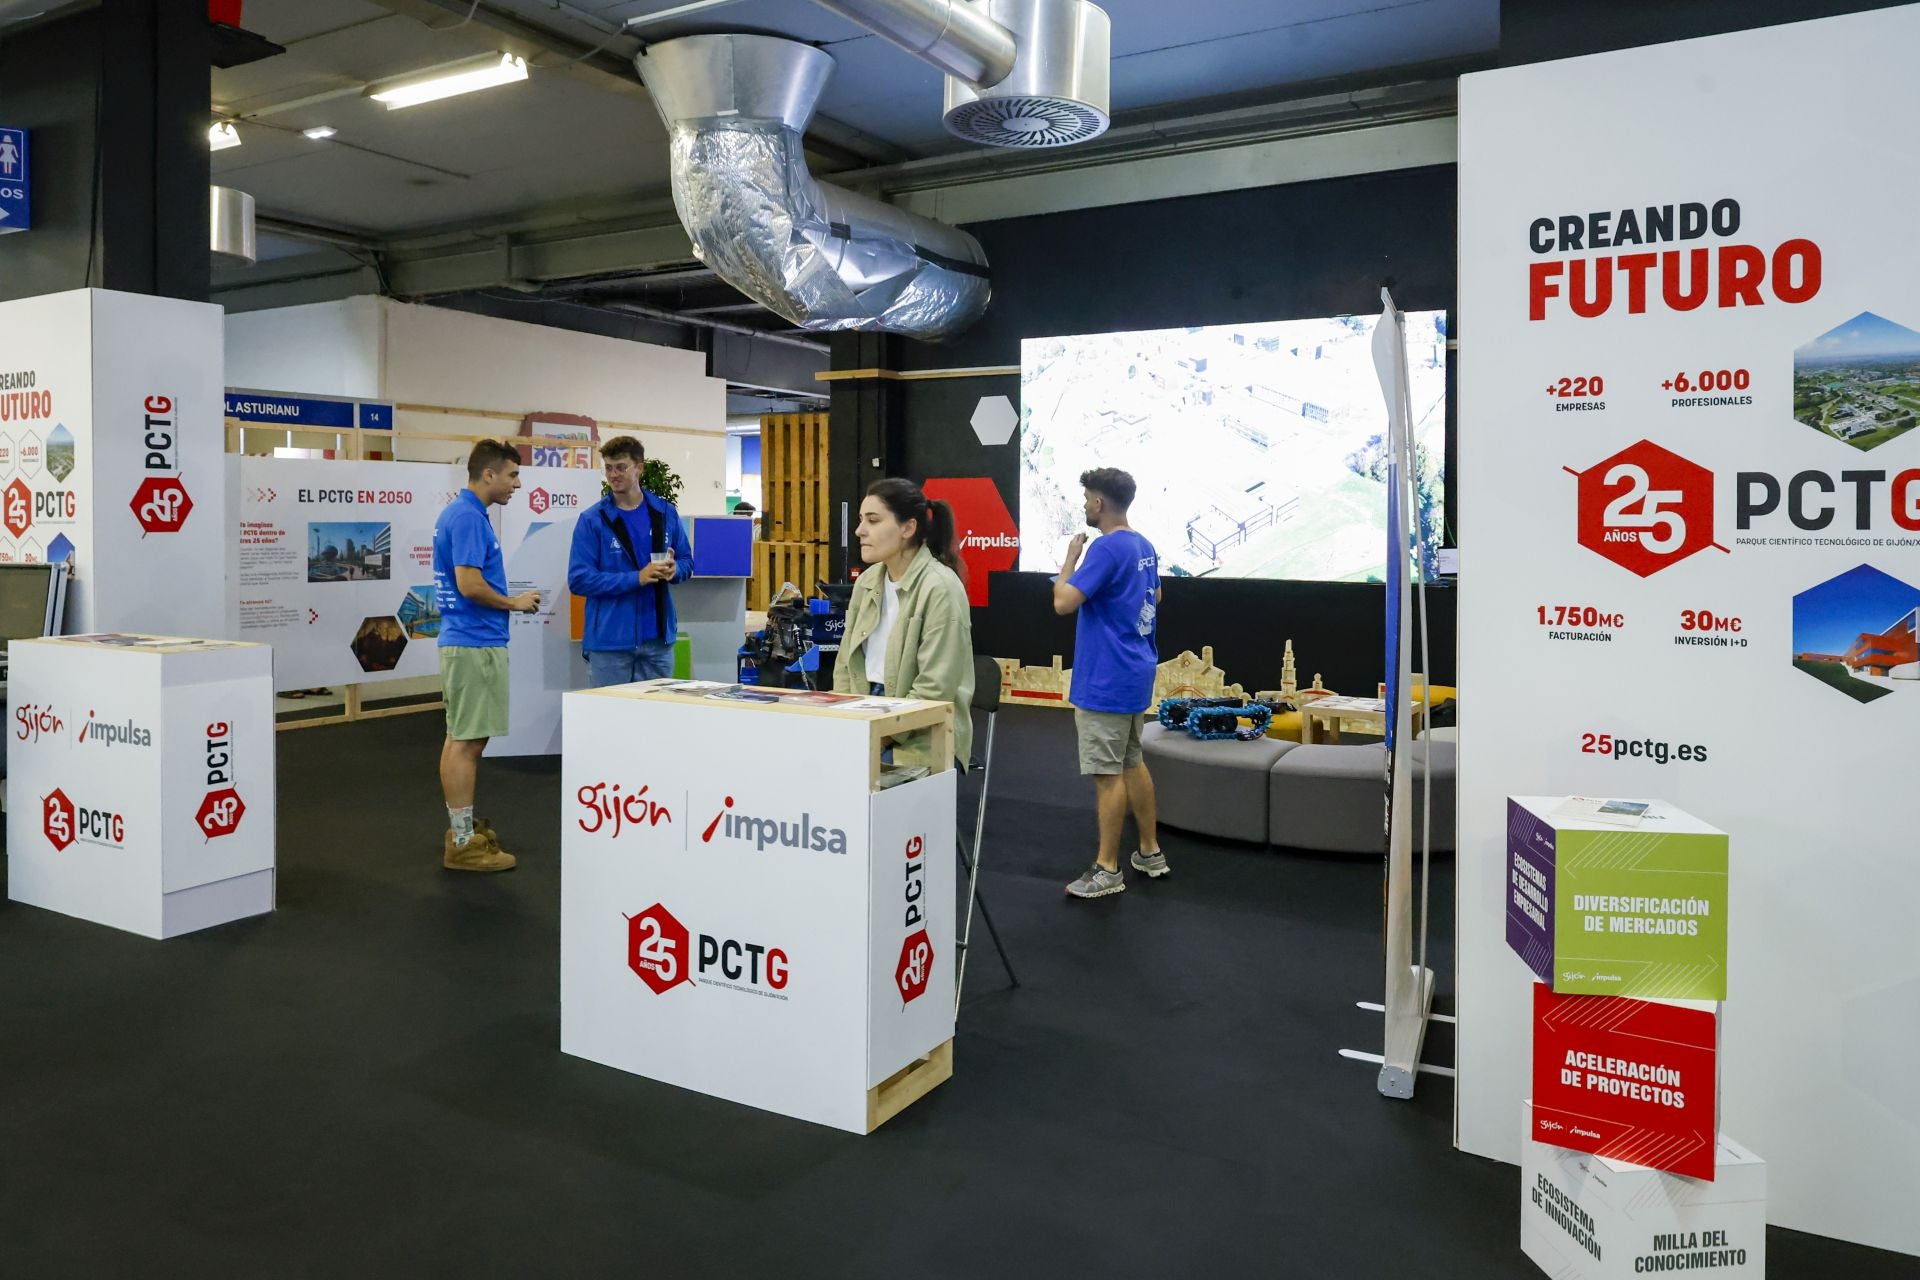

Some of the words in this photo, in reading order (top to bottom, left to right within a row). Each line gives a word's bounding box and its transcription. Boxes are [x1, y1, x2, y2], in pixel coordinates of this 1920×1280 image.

[1, 187, 24, 199] OS
[1529, 198, 1741, 254] CREANDO
[1529, 238, 1822, 321] FUTURO
[1546, 375, 1604, 397] +220
[1661, 368, 1750, 393] +6.000
[235, 402, 300, 417] ASTURIANU
[1556, 401, 1606, 412] EMPRESAS
[1671, 395, 1753, 407] PROFESIONALES
[370, 413, 379, 422] 14
[144, 395, 172, 469] PCTG
[8, 487, 27, 529] 25
[35, 490, 76, 518] PCTG
[141, 488, 184, 523] 25
[298, 489, 315, 503] EL
[318, 489, 354, 504] PCTG
[357, 490, 375, 504] EN
[378, 490, 413, 504] 2050
[532, 491, 546, 510] 25
[551, 493, 578, 506] PCTG
[1602, 463, 1687, 554] 25
[1736, 468, 1920, 531] PCTG
[959, 529, 1020, 551] impulsa
[1603, 528, 1638, 543] AÑOS
[1736, 538, 1767, 546] PARQUE
[1768, 536, 1813, 546] CIENTÍFICO
[1814, 536, 1871, 546] TECNOLÓGICO
[1872, 538, 1884, 546] DE
[825, 619, 846, 632] gijó
[1537, 605, 1625, 628] 1.750M€
[1680, 609, 1742, 633] 30M€
[1549, 631, 1612, 642] FACTURACIÓN
[1674, 635, 1728, 647] INVERSIÓN
[1730, 637, 1748, 648] I+D
[16, 704, 64, 743] gijón
[78, 709, 151, 747] impulsa
[207, 721, 229, 785] PCTG
[1581, 733, 1708, 765] 25pctg.es
[49, 797, 70, 842] 25
[79, 807, 124, 843] PCTG
[203, 797, 238, 830] 25
[577, 782, 672, 839] gijón
[702, 796, 847, 855] impulsa
[905, 835, 923, 928] PCTG
[1513, 851, 1547, 892] ECOSISTEMAS
[1512, 868, 1519, 887] DE
[1519, 874, 1549, 913] DESARROLLO
[1513, 888, 1546, 932] EMPRESARIAL
[1573, 894, 1710, 916] DIVERSIFICACIÓN
[1584, 916, 1604, 932] DE
[1609, 916, 1698, 936] MERCADOS
[639, 916, 678, 982] 25
[699, 933, 788, 990] PCTG
[639, 959, 656, 971] AÑOS
[901, 941, 929, 991] 25
[1564, 1049, 1681, 1088] ACELERACIÓN
[1561, 1068, 1582, 1088] DE
[1586, 1073, 1685, 1109] PROYECTOS
[1569, 1125, 1601, 1139] impulsa
[1537, 1172, 1596, 1236] ECOSISTEMA
[1531, 1186, 1543, 1209] DE
[1545, 1201, 1602, 1263] INNOVACIÓN
[1653, 1231, 1698, 1252] MILLA
[1702, 1230, 1729, 1248] DEL
[1634, 1249, 1747, 1274] CONOCIMIENTO
